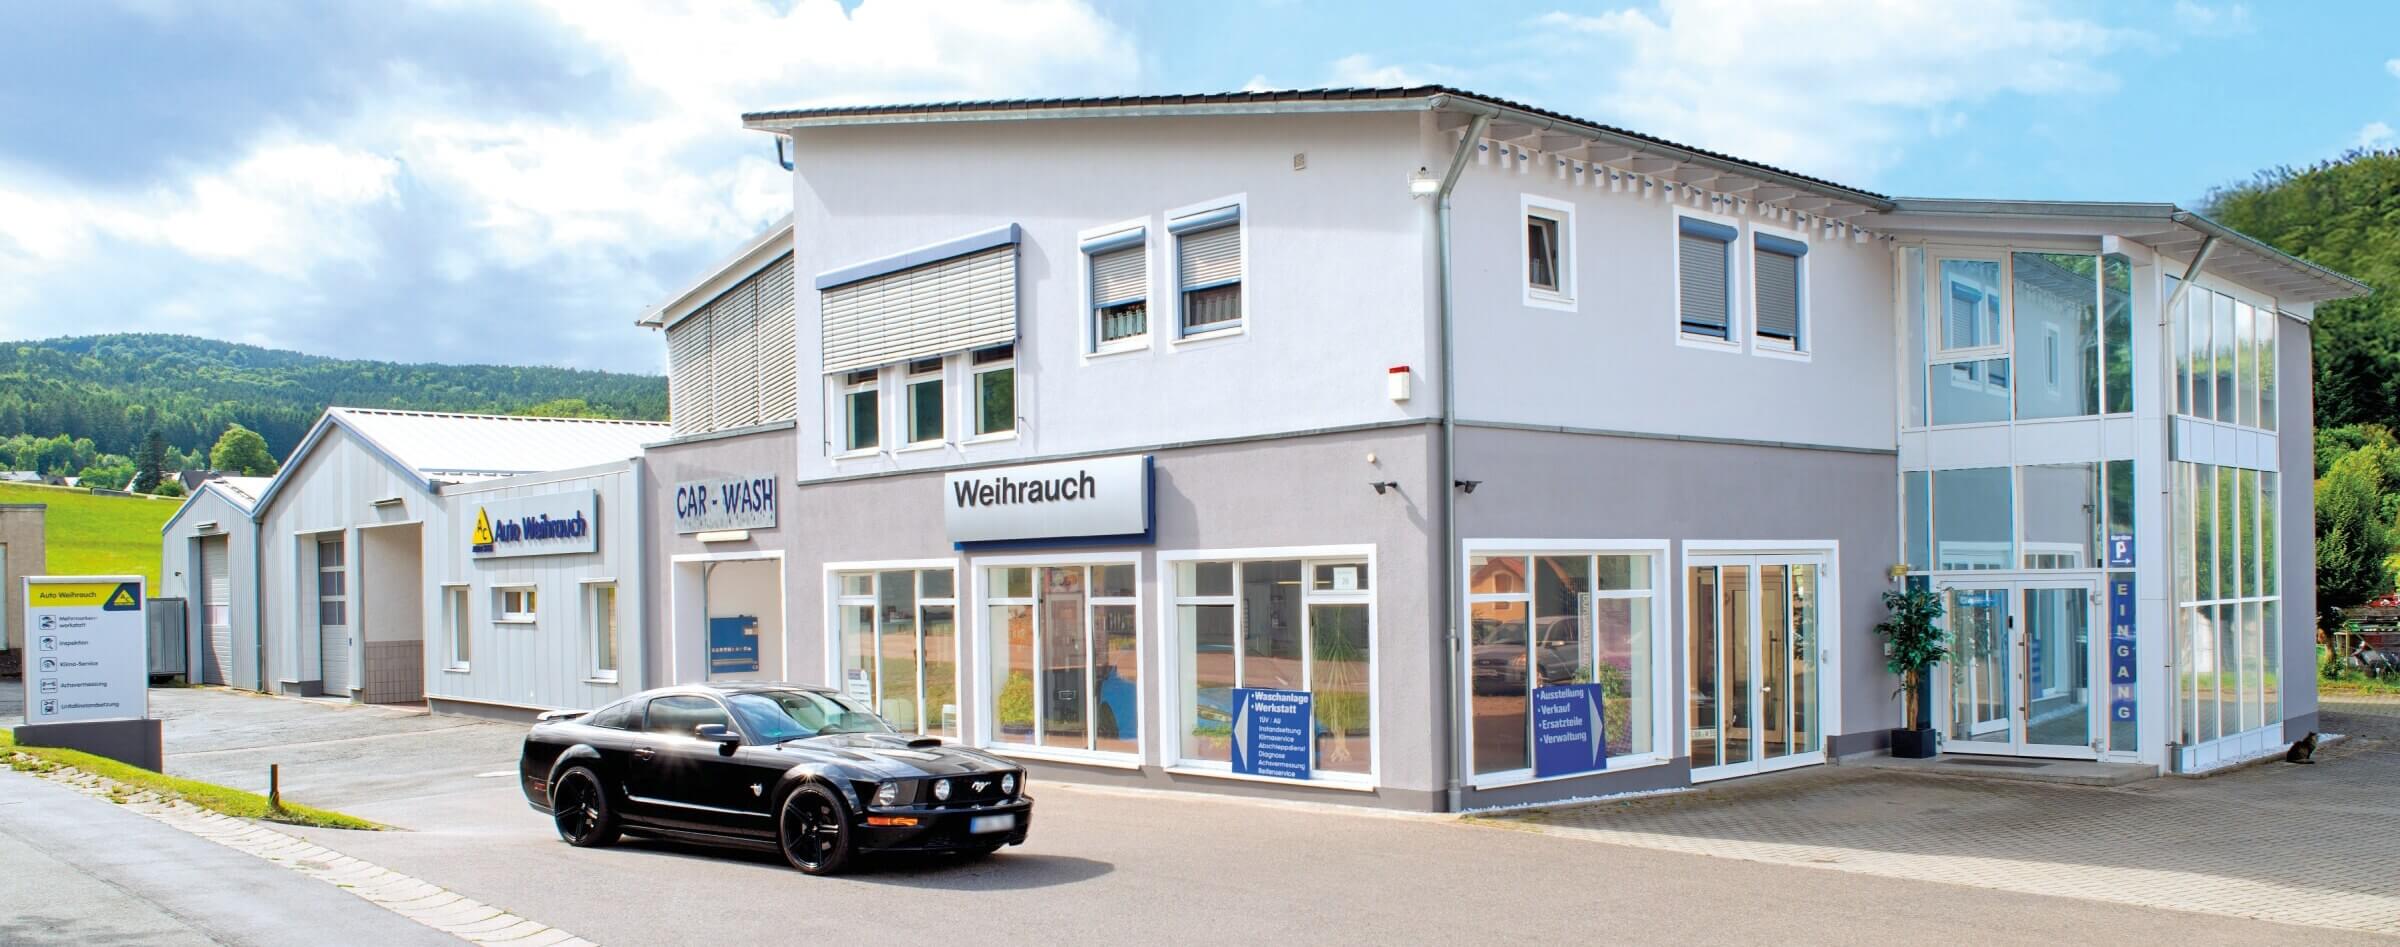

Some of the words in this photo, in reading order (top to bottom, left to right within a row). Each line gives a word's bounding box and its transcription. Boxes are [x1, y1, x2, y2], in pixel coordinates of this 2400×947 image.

[954, 470, 1095, 508] Weihrauch
[677, 485, 707, 519] CAR
[722, 479, 773, 515] WASH
[494, 519, 521, 542] Auto
[522, 510, 587, 541] Weihrauch
[58, 591, 97, 599] Weihrauch
[2117, 584, 2130, 719] EINGANG
[1254, 691, 1309, 704] Waschanlage
[1540, 688, 1584, 700] Ausstellung
[1254, 702, 1297, 714] Werkstatt
[1541, 702, 1570, 714] Verkauf
[1542, 717, 1583, 730] Ersatzteile
[1543, 732, 1588, 744] Verwaltung
